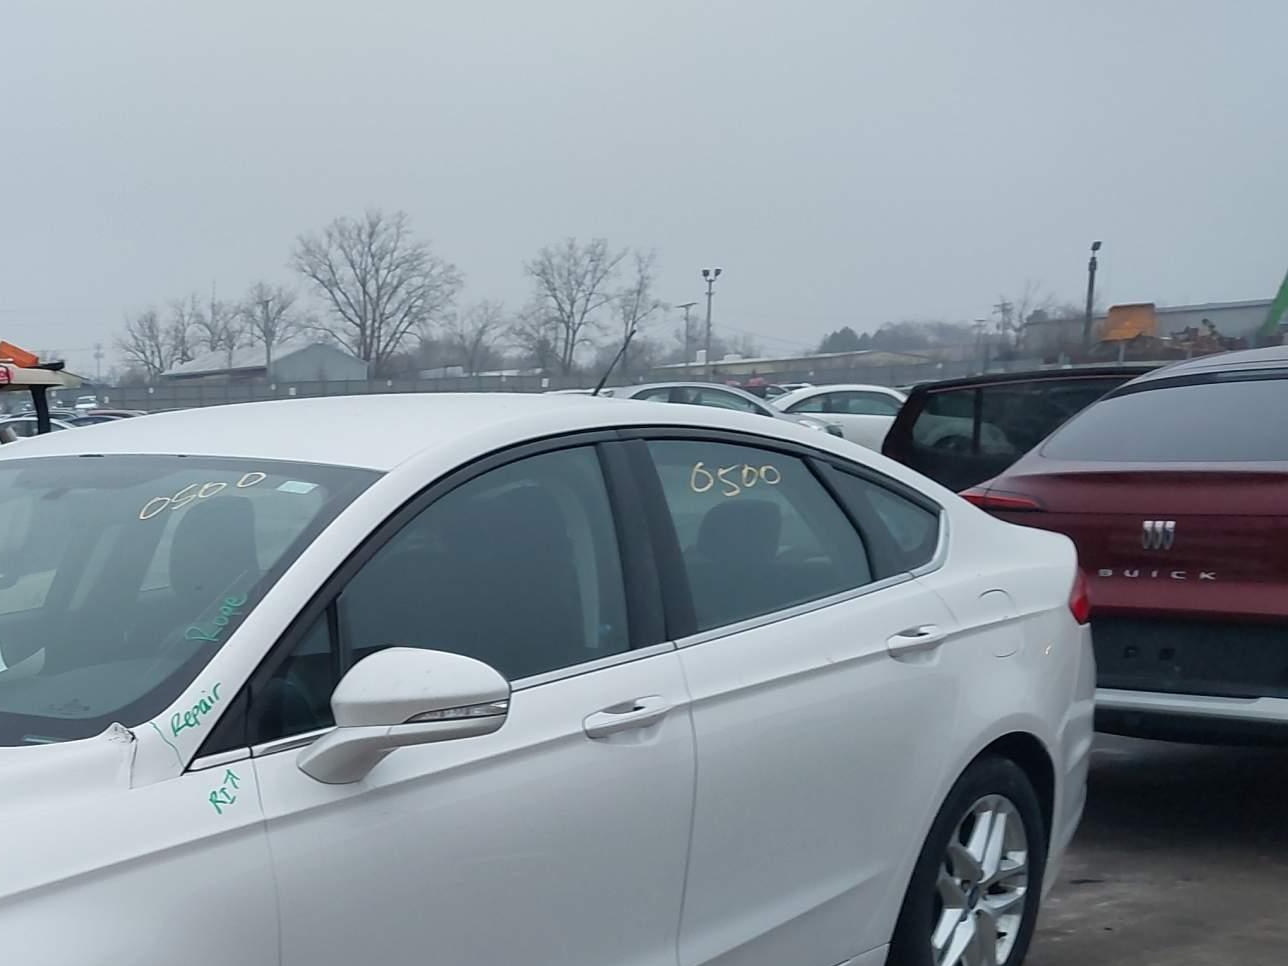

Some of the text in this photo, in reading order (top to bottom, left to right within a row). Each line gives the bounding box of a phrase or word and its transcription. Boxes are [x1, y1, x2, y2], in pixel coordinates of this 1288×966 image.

[139, 471, 266, 520] 0500
[1098, 568, 1216, 580] BUICK
[171, 682, 221, 737] Repair
